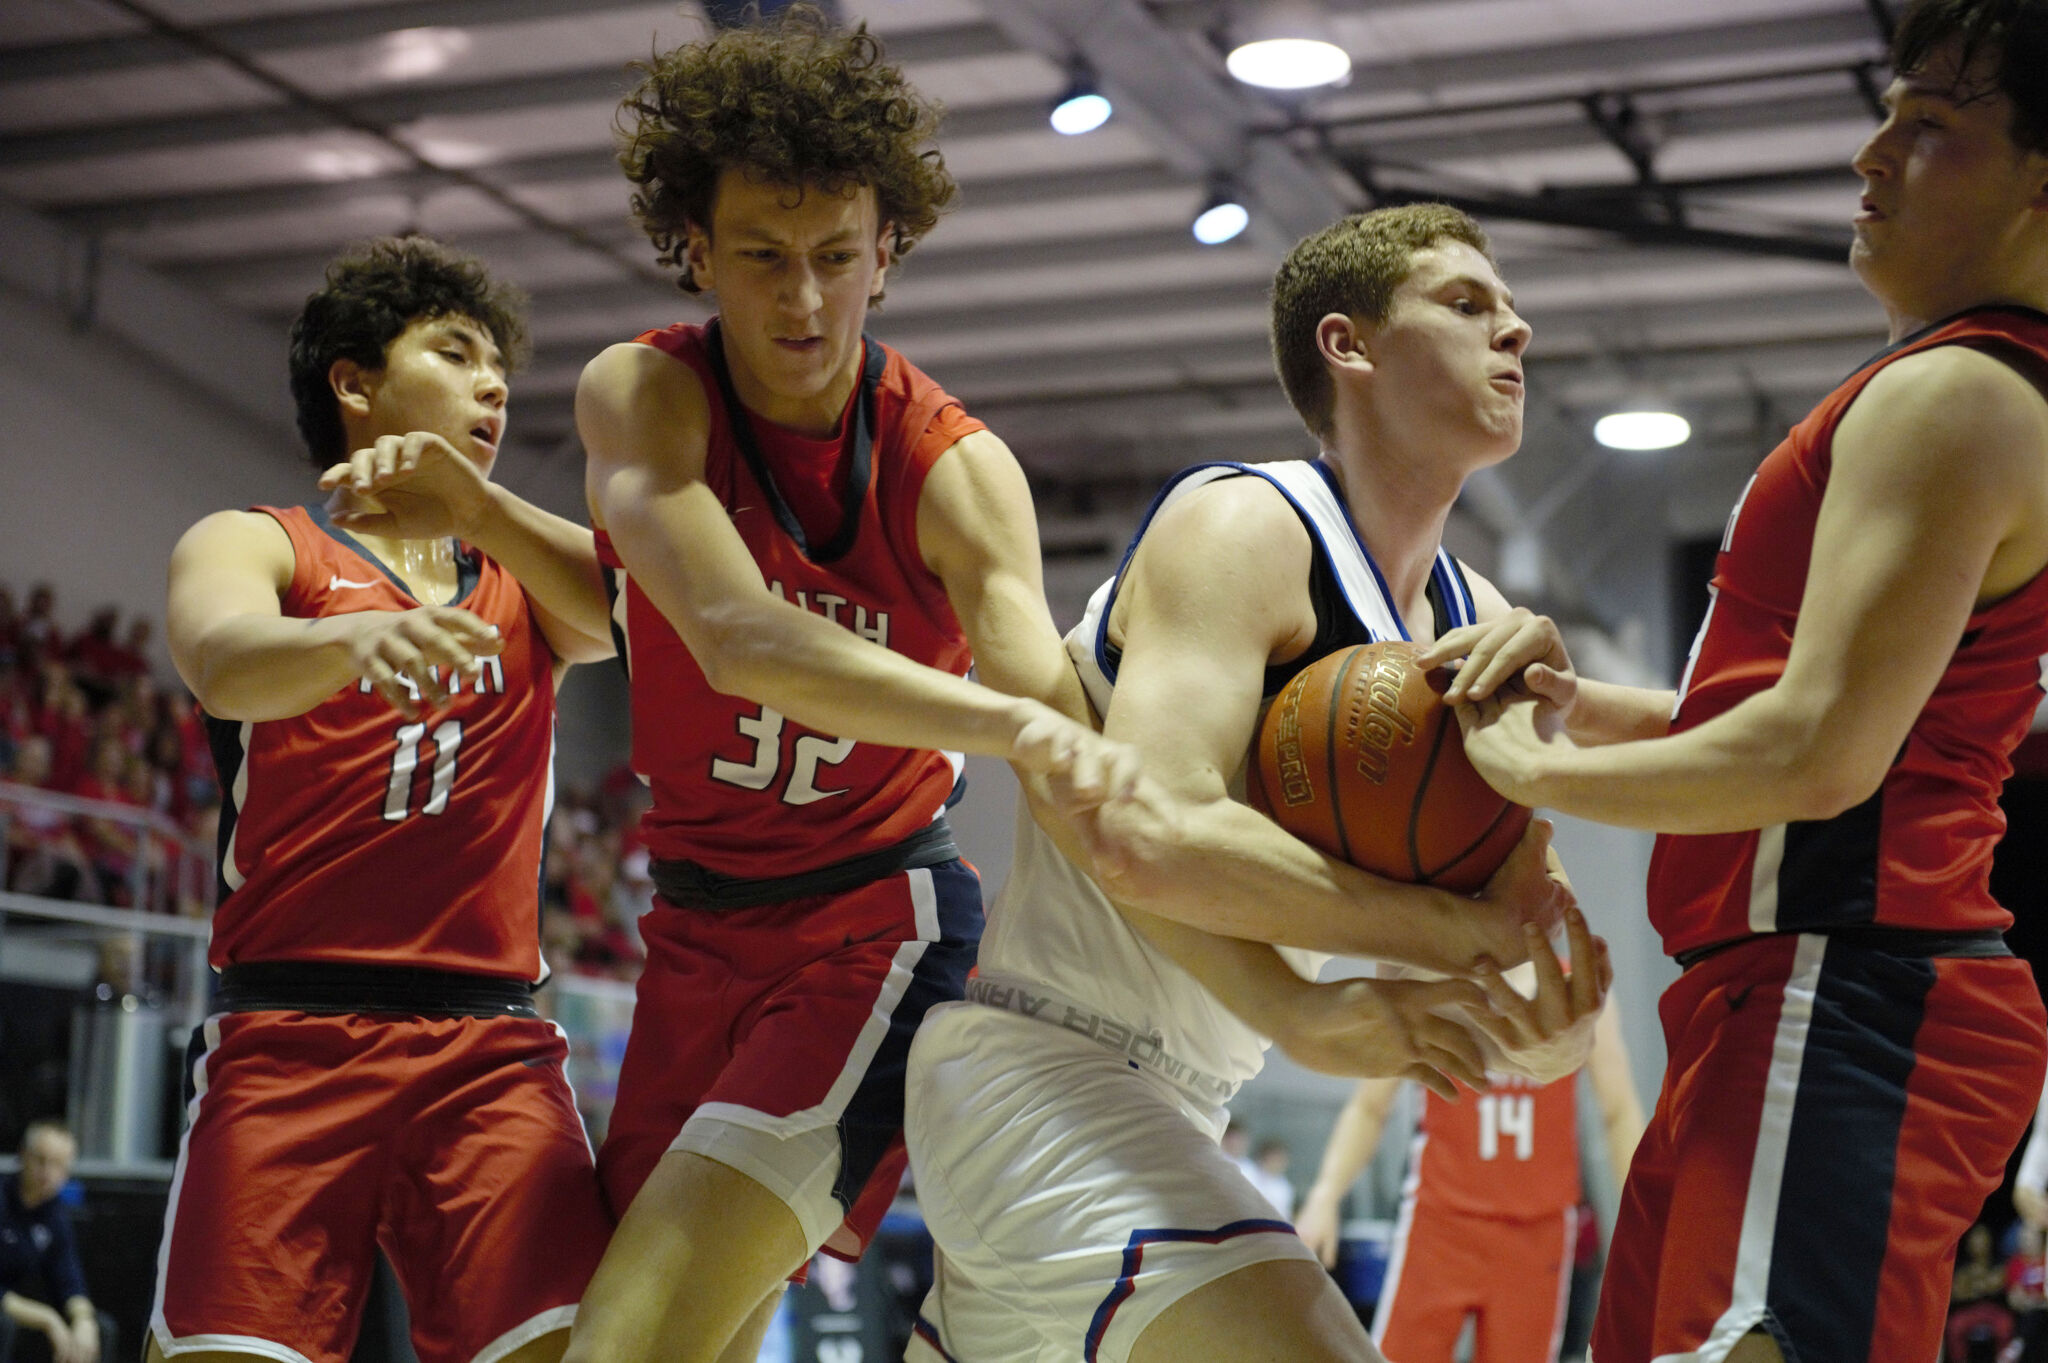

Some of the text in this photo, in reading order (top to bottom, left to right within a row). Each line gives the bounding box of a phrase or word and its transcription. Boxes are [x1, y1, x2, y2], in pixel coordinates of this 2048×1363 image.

[383, 719, 463, 821] 11
[711, 704, 857, 806] 32
[1477, 1093, 1535, 1162] 14
